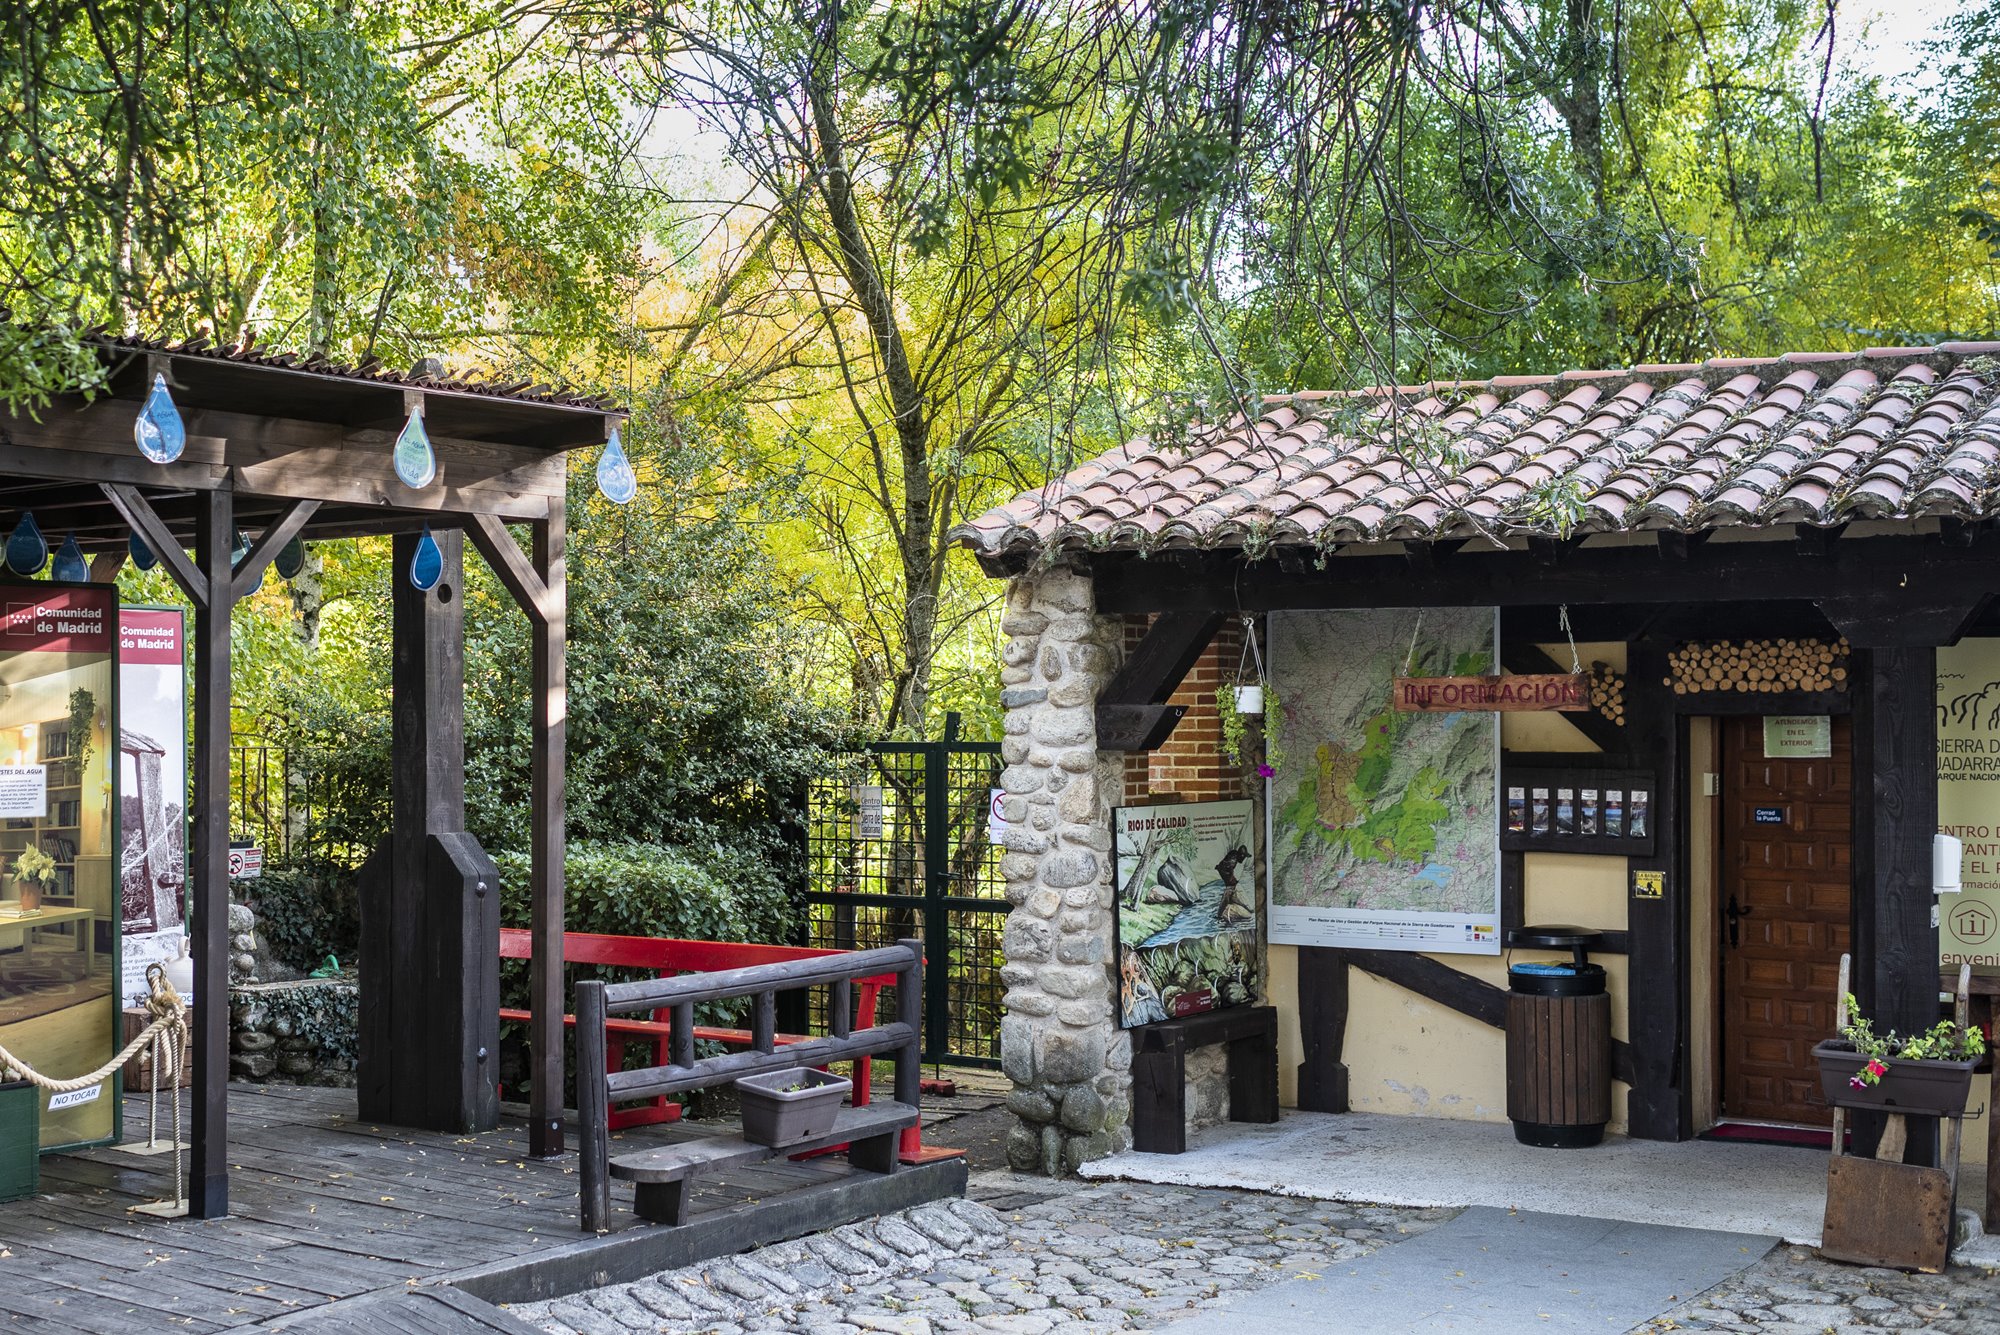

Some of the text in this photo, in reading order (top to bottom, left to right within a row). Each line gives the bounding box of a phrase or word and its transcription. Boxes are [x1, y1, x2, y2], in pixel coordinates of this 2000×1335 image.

[36, 606, 102, 618] Comunidad
[37, 622, 102, 634] de Madrid
[120, 626, 174, 636] Comunidad
[121, 638, 174, 650] de Madrid
[1404, 678, 1578, 704] INFORMACIÓN
[874, 810, 880, 824] de
[1128, 819, 1144, 832] RIOS
[1146, 818, 1154, 830] DE
[1156, 816, 1187, 830] CALIDAD
[1972, 862, 1990, 874] EL
[54, 1088, 97, 1105] NO TOCAR
